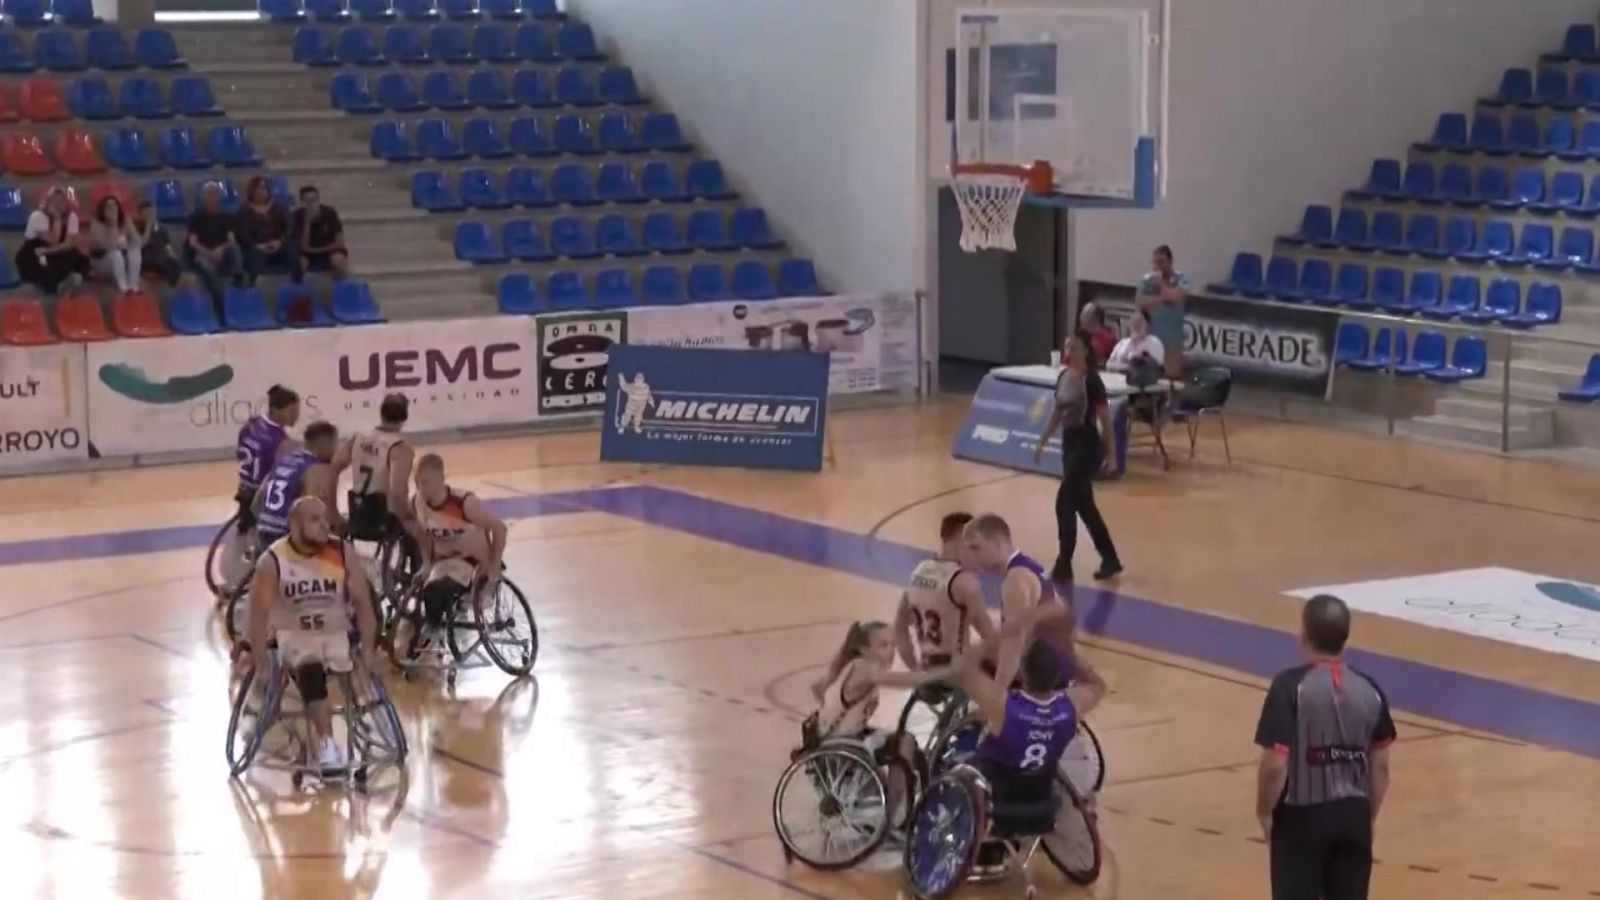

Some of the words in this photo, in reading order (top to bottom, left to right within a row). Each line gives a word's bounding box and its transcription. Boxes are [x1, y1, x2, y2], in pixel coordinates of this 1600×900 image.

[338, 342, 522, 391] UEMC
[189, 391, 323, 428] alias
[344, 387, 520, 411] UNERSIDAD
[655, 399, 811, 424] MICHELIN
[0, 427, 80, 453] ROYO
[359, 464, 374, 495] 7
[264, 479, 288, 511] 13
[284, 578, 337, 598] UCAM
[299, 613, 325, 631] 55
[911, 605, 942, 647] 13
[1020, 743, 1047, 770] 8
